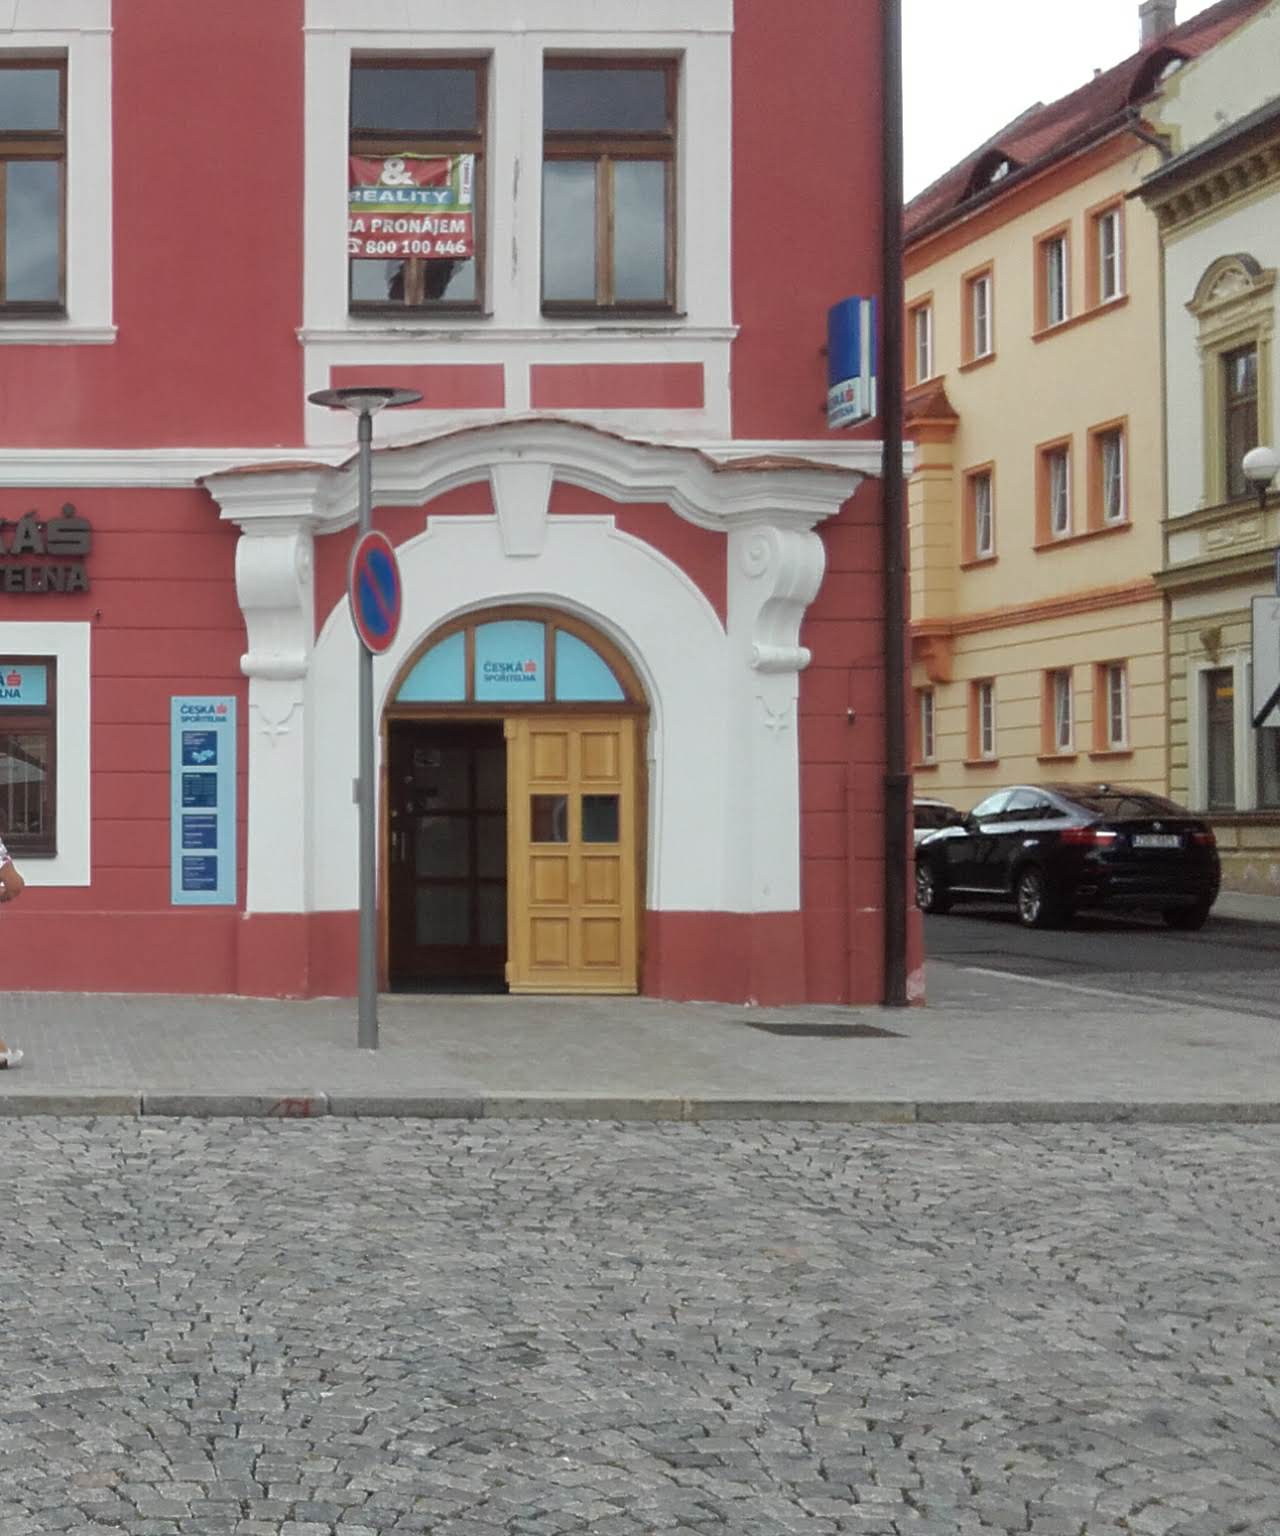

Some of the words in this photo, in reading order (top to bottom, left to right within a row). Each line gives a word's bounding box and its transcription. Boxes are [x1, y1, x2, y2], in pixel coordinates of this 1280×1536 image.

[371, 216, 466, 236] PRONÁJEM
[365, 240, 397, 254] 800
[402, 240, 431, 254] 100
[435, 239, 467, 254] 446
